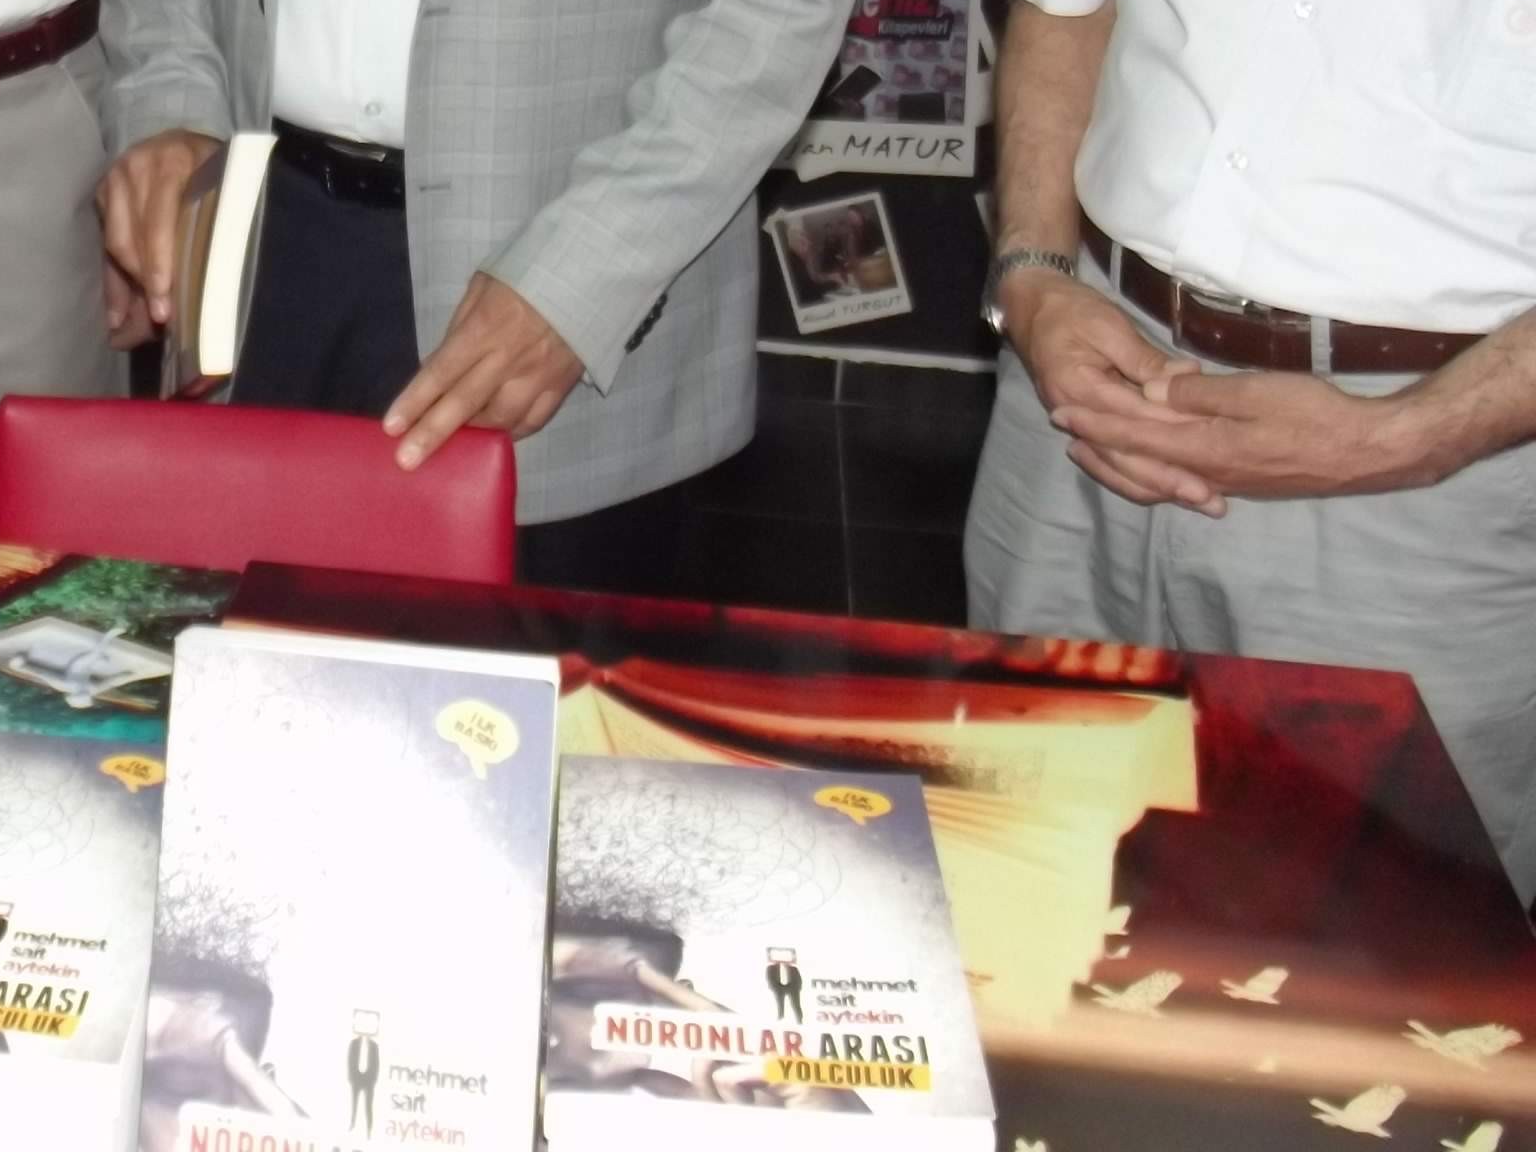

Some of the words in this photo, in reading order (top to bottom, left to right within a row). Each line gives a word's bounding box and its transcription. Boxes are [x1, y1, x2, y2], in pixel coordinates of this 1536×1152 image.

[842, 133, 965, 162] MATUR
[13, 930, 107, 952] mehmet
[2, 958, 81, 979] aytekin
[811, 976, 918, 993] mehmet
[816, 991, 858, 1008] sait
[815, 1008, 905, 1025] aytekin
[605, 1011, 804, 1058] NÖRONLAR
[818, 1032, 930, 1065] ARASI
[388, 1063, 489, 1096] mehmet
[776, 1058, 915, 1089] YOLCULUK
[383, 1116, 468, 1147] aytekin
